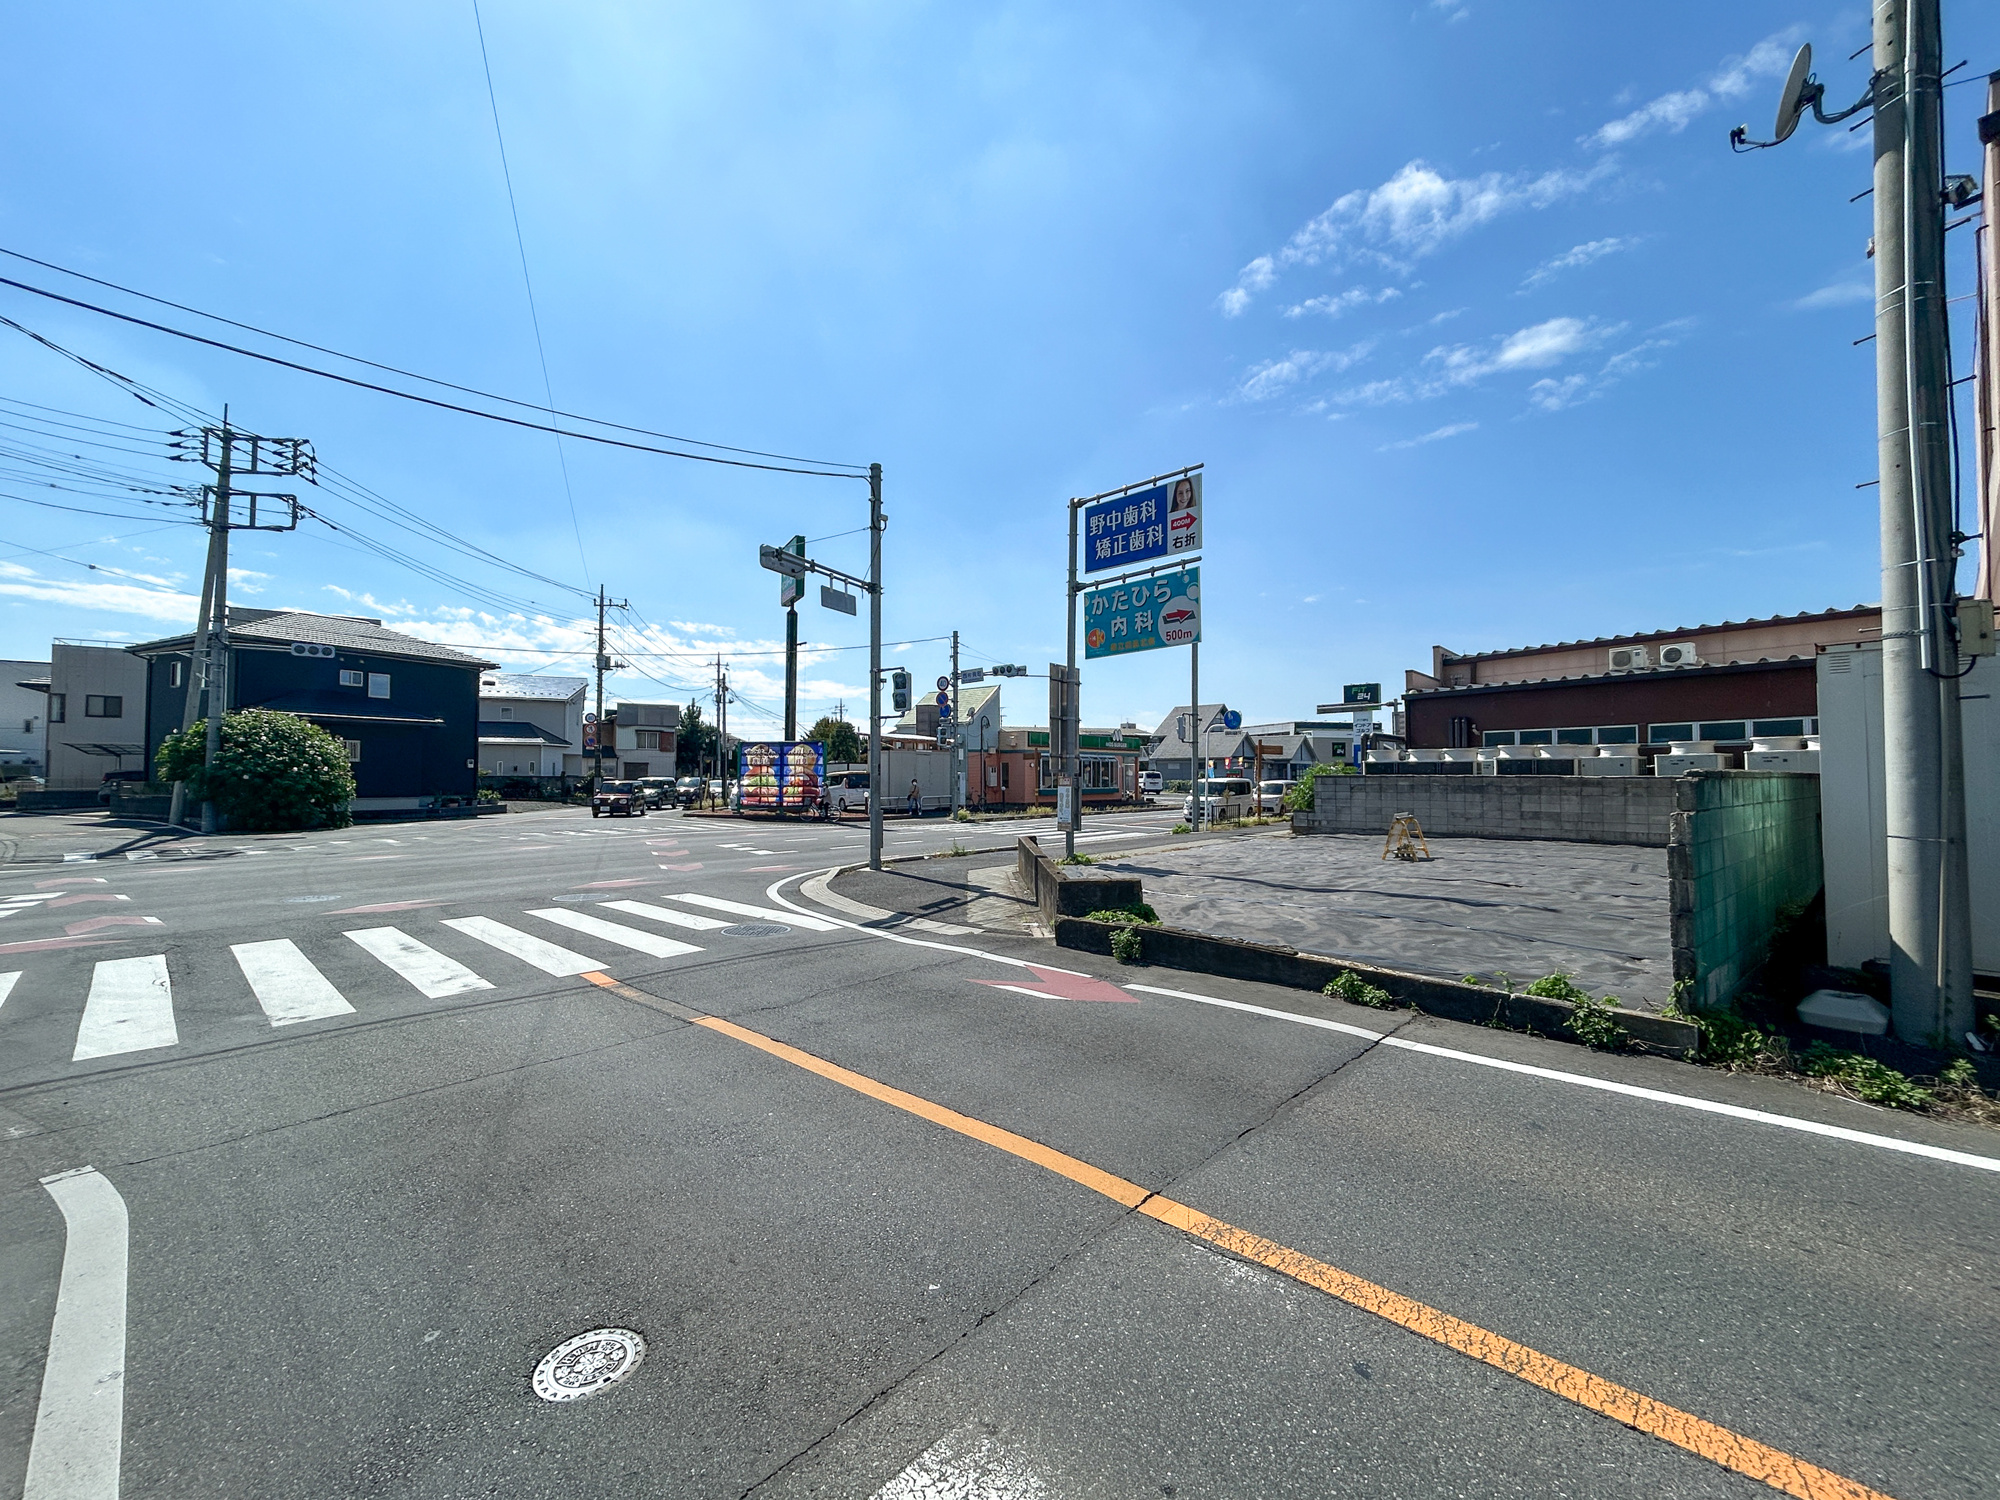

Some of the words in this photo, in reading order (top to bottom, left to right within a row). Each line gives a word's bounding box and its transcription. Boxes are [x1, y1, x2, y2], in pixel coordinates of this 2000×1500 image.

[1089, 499, 1157, 536] 野中歯科
[1173, 518, 1191, 527] 400M
[1095, 523, 1164, 560] 矯正歯科
[1172, 532, 1196, 549] 右折
[1091, 579, 1171, 615] かたひら
[1111, 609, 1154, 638] 内科
[1165, 629, 1192, 641] 500m
[1357, 692, 1370, 700] 24
